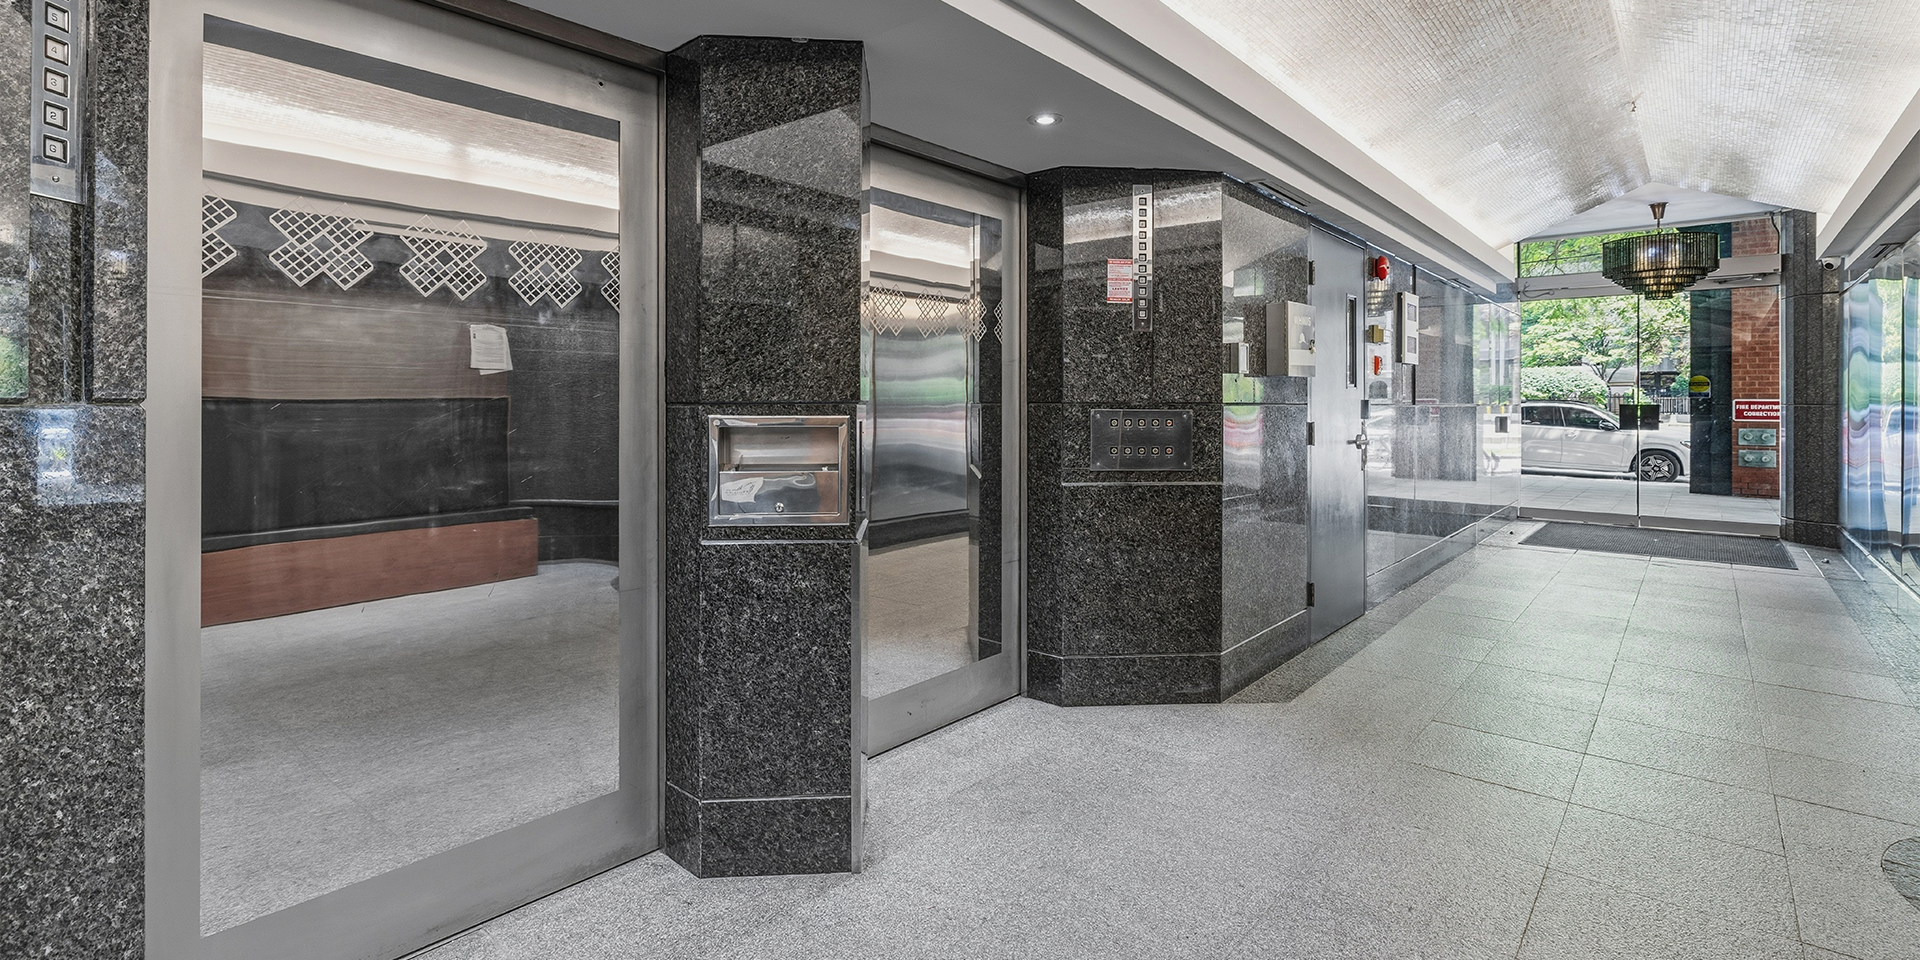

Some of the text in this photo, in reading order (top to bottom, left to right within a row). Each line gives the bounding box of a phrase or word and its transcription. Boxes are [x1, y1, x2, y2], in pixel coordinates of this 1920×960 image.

[51, 46, 57, 54] 4
[50, 77, 57, 87] 3
[50, 111, 57, 121] 2
[49, 144, 57, 153] G
